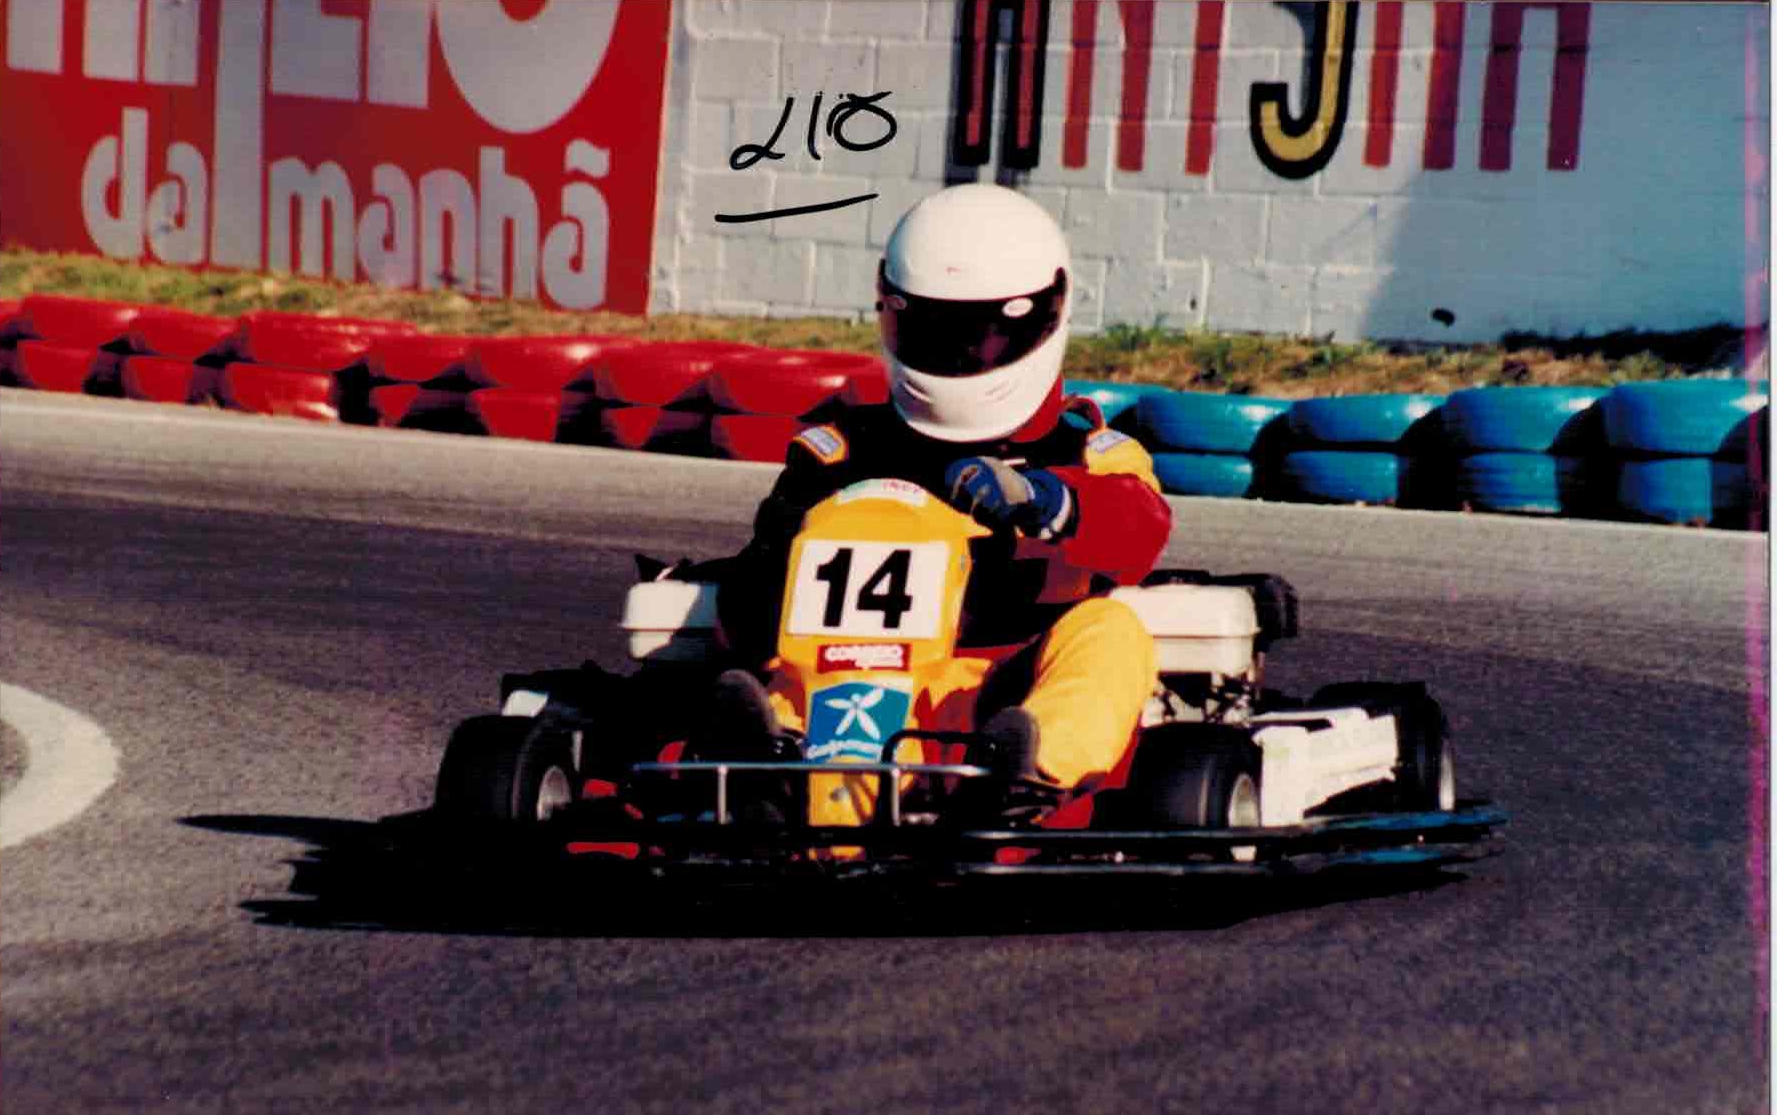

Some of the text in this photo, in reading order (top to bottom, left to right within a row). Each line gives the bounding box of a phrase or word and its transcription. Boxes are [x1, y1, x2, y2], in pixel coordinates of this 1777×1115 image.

[81, 107, 610, 309] da manhã
[815, 548, 914, 629] 14
